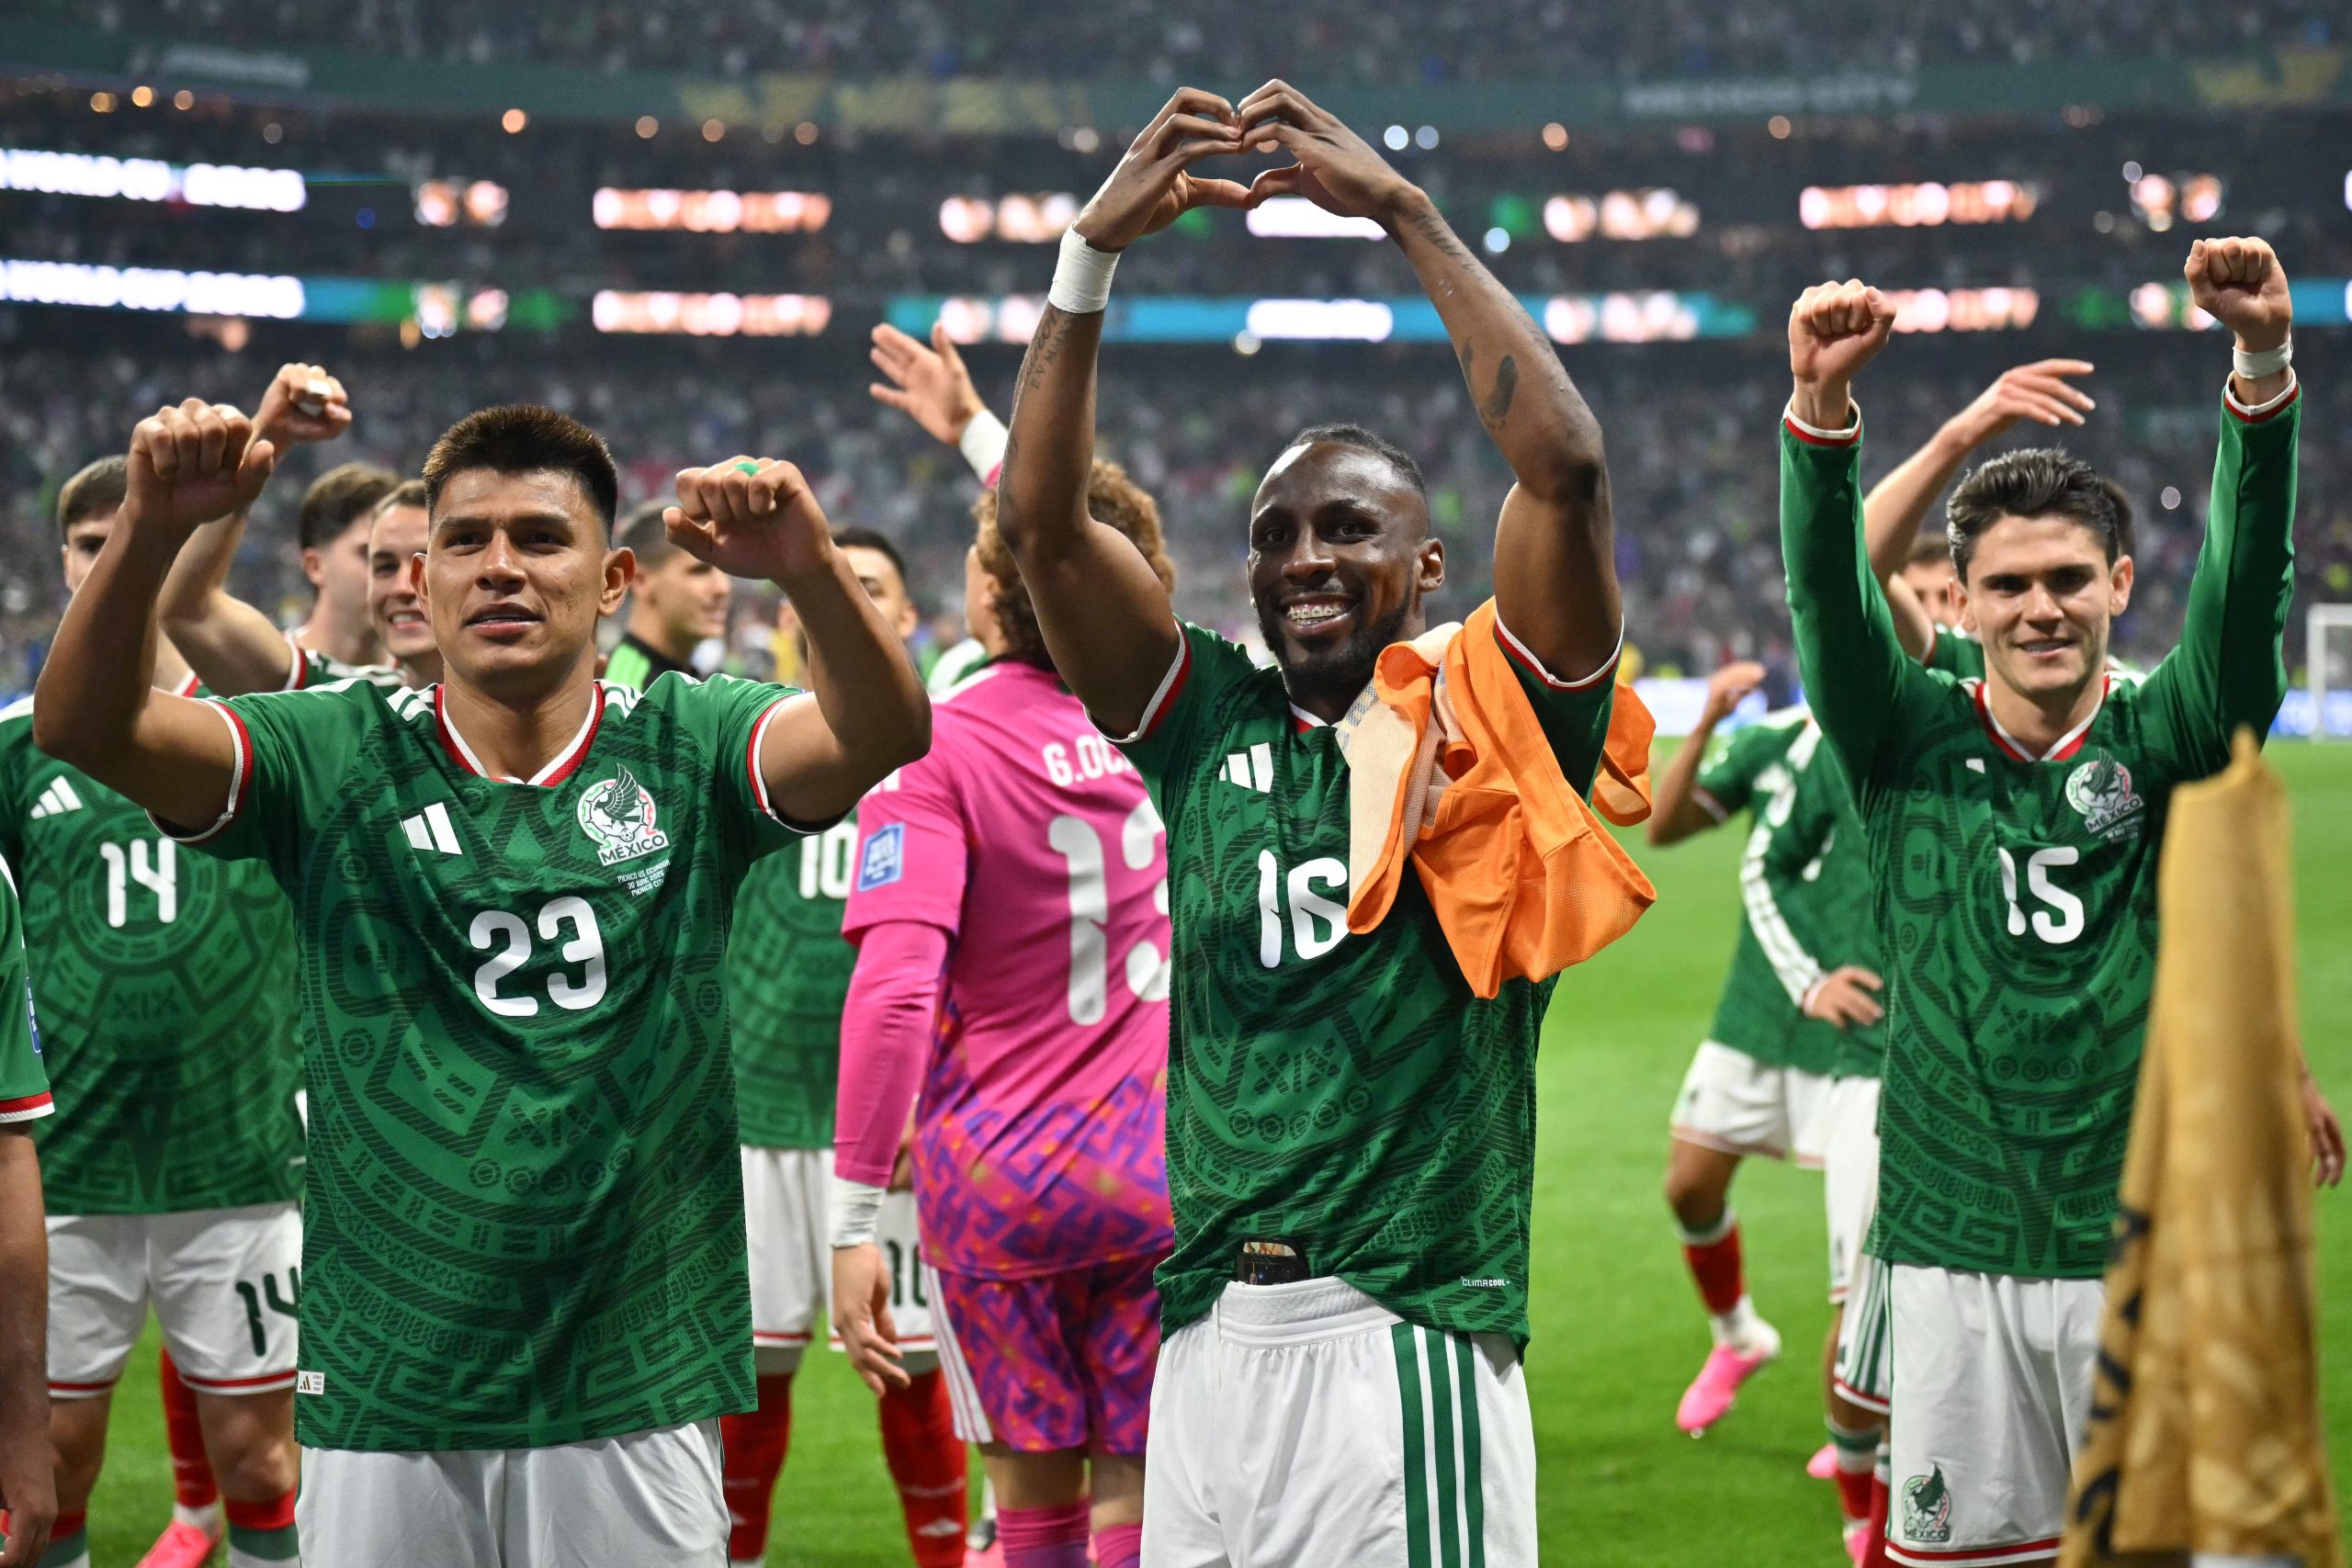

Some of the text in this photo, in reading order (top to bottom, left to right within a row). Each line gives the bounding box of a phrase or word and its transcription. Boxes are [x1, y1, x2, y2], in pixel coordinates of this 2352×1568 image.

[1042, 733, 1133, 787] G.OC
[100, 837, 176, 928] 14
[600, 835, 664, 863] MÉXICO
[628, 881, 636, 890] 30
[799, 821, 858, 899] 10
[1998, 846, 2085, 943] 15
[1258, 849, 1350, 968] 16
[469, 896, 607, 1017] 23
[235, 1267, 301, 1358] 14
